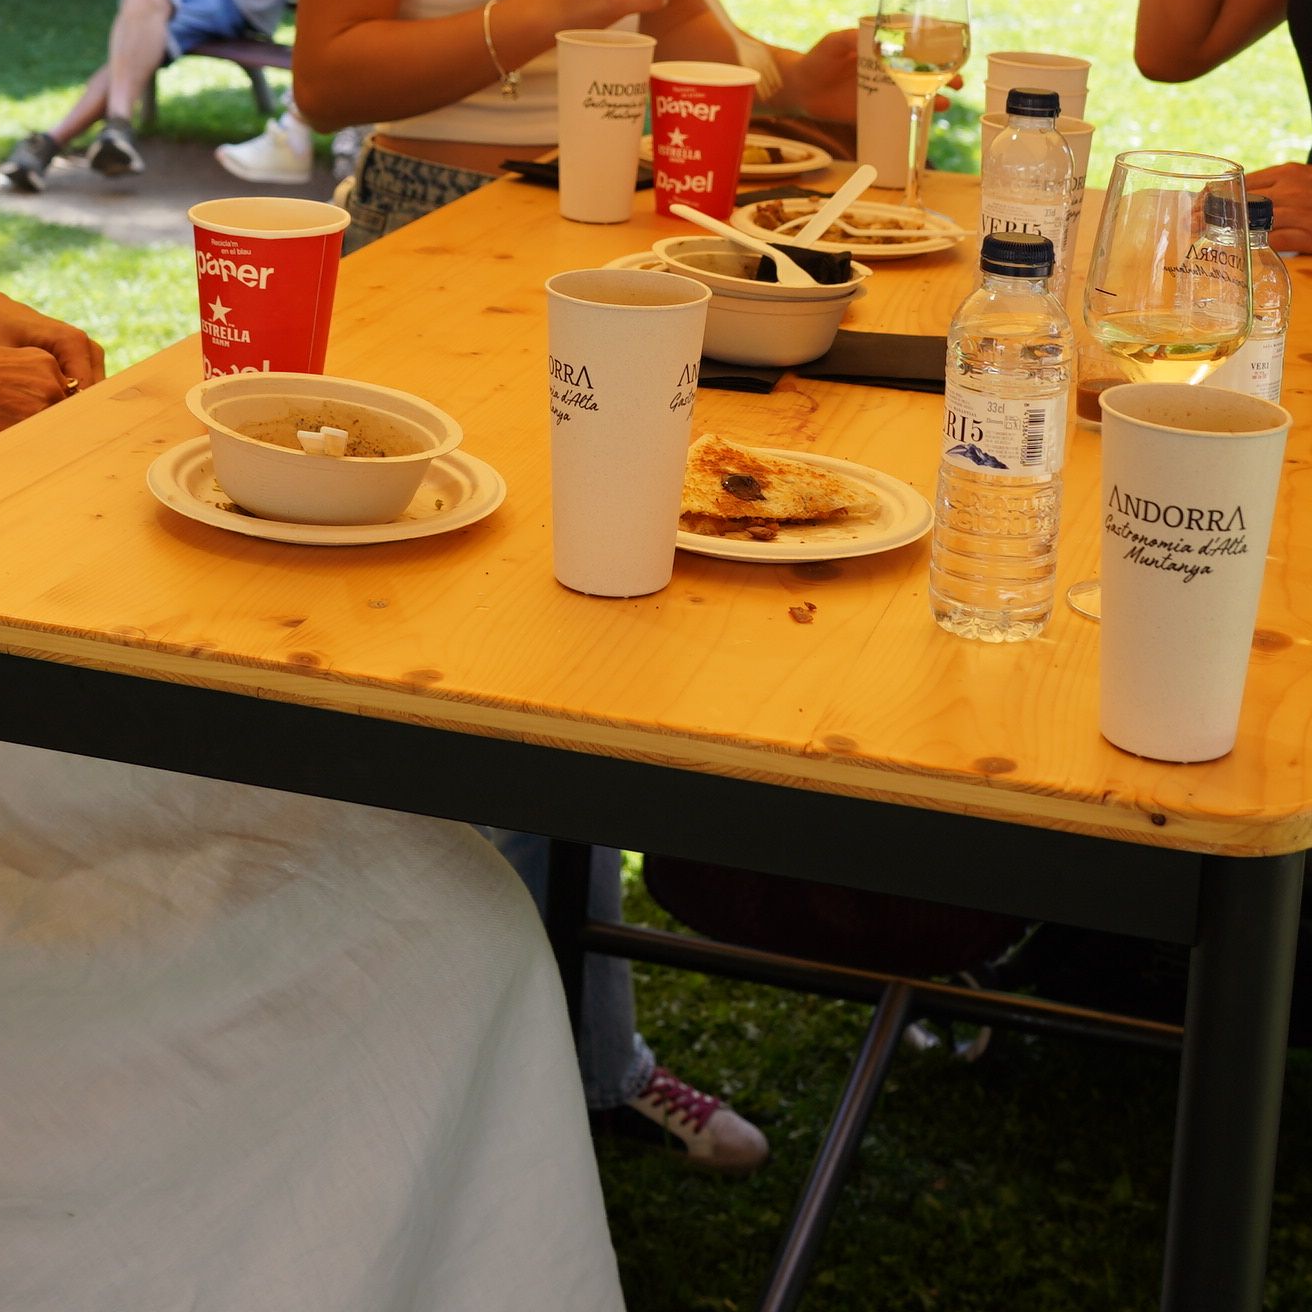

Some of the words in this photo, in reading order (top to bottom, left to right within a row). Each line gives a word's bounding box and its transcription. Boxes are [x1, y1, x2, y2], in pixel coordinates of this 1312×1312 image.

[987, 401, 1005, 414] 33cl
[1108, 484, 1246, 532] ANDORRA
[1123, 545, 1213, 584] Muntanya
